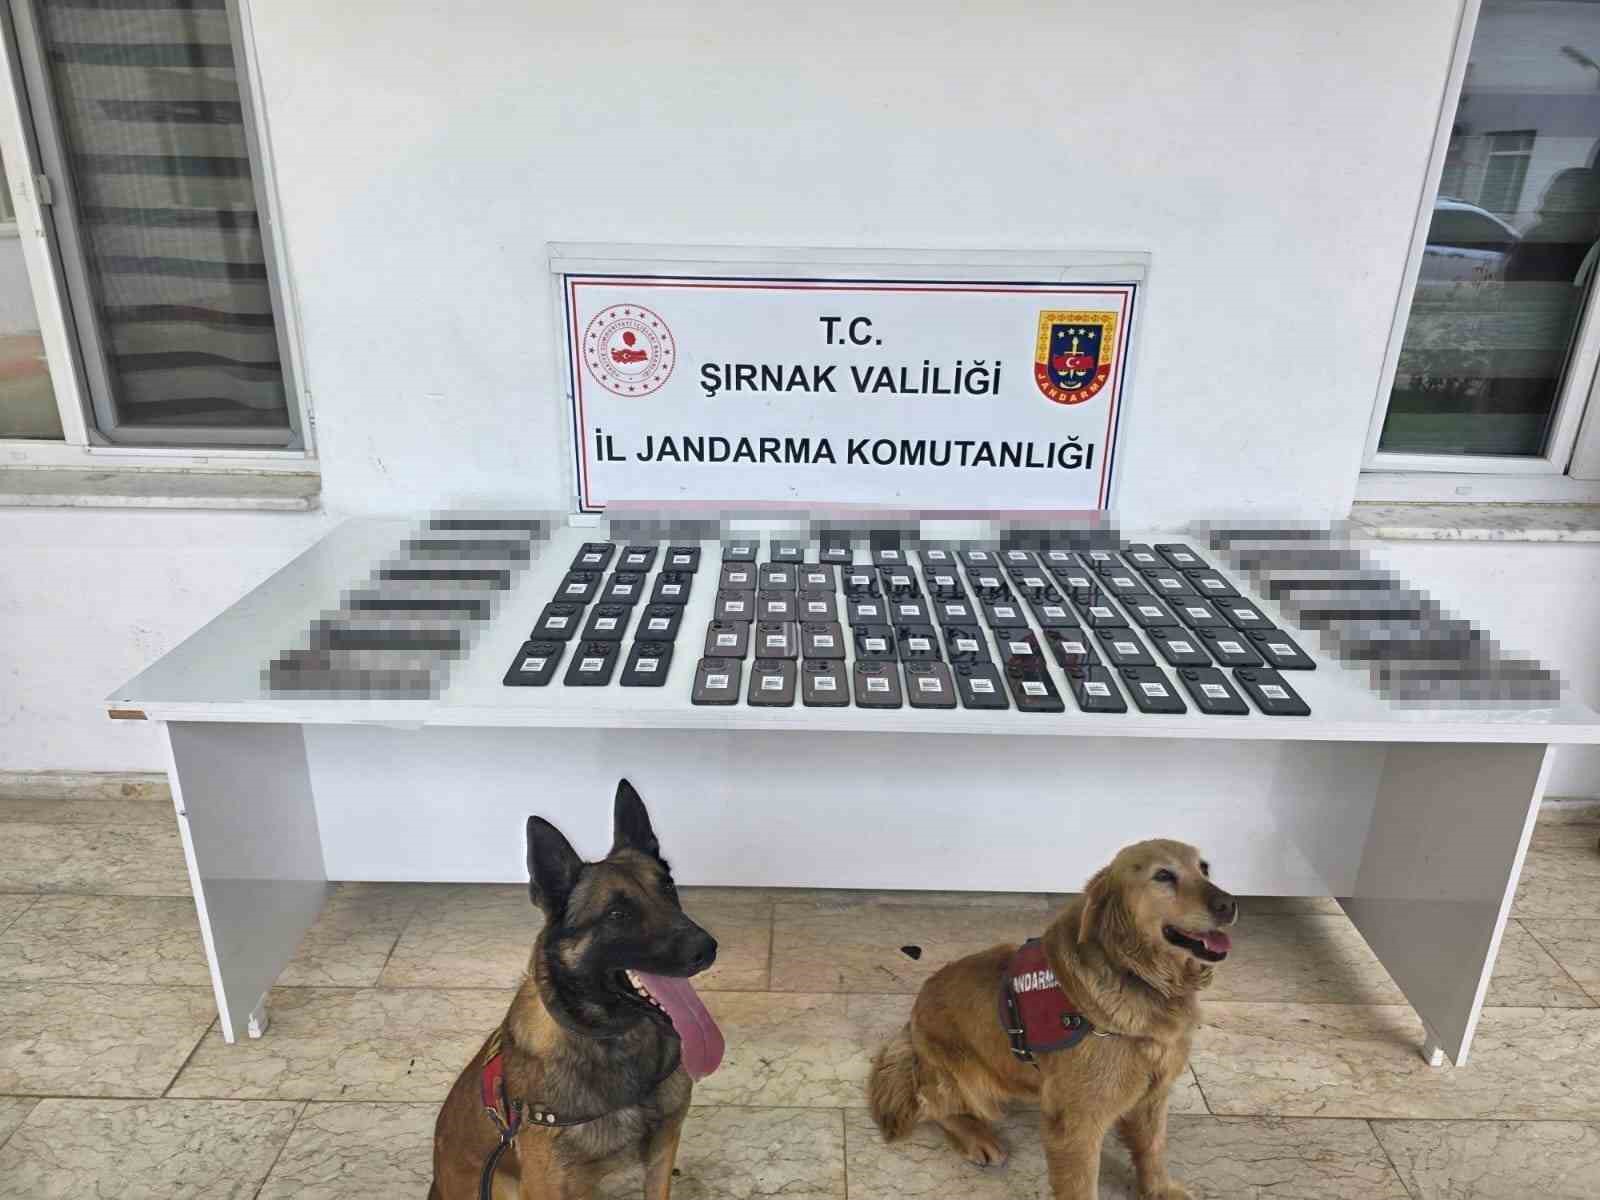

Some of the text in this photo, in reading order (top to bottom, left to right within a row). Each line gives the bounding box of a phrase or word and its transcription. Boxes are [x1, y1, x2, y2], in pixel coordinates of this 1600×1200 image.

[819, 316, 882, 346] T.C.
[700, 359, 1002, 398] ŞIRNAK VALİLİĞİ
[1038, 374, 1106, 401] JANDARMA
[595, 427, 1095, 470] İL JANDARMA KOMUTANLIĞI
